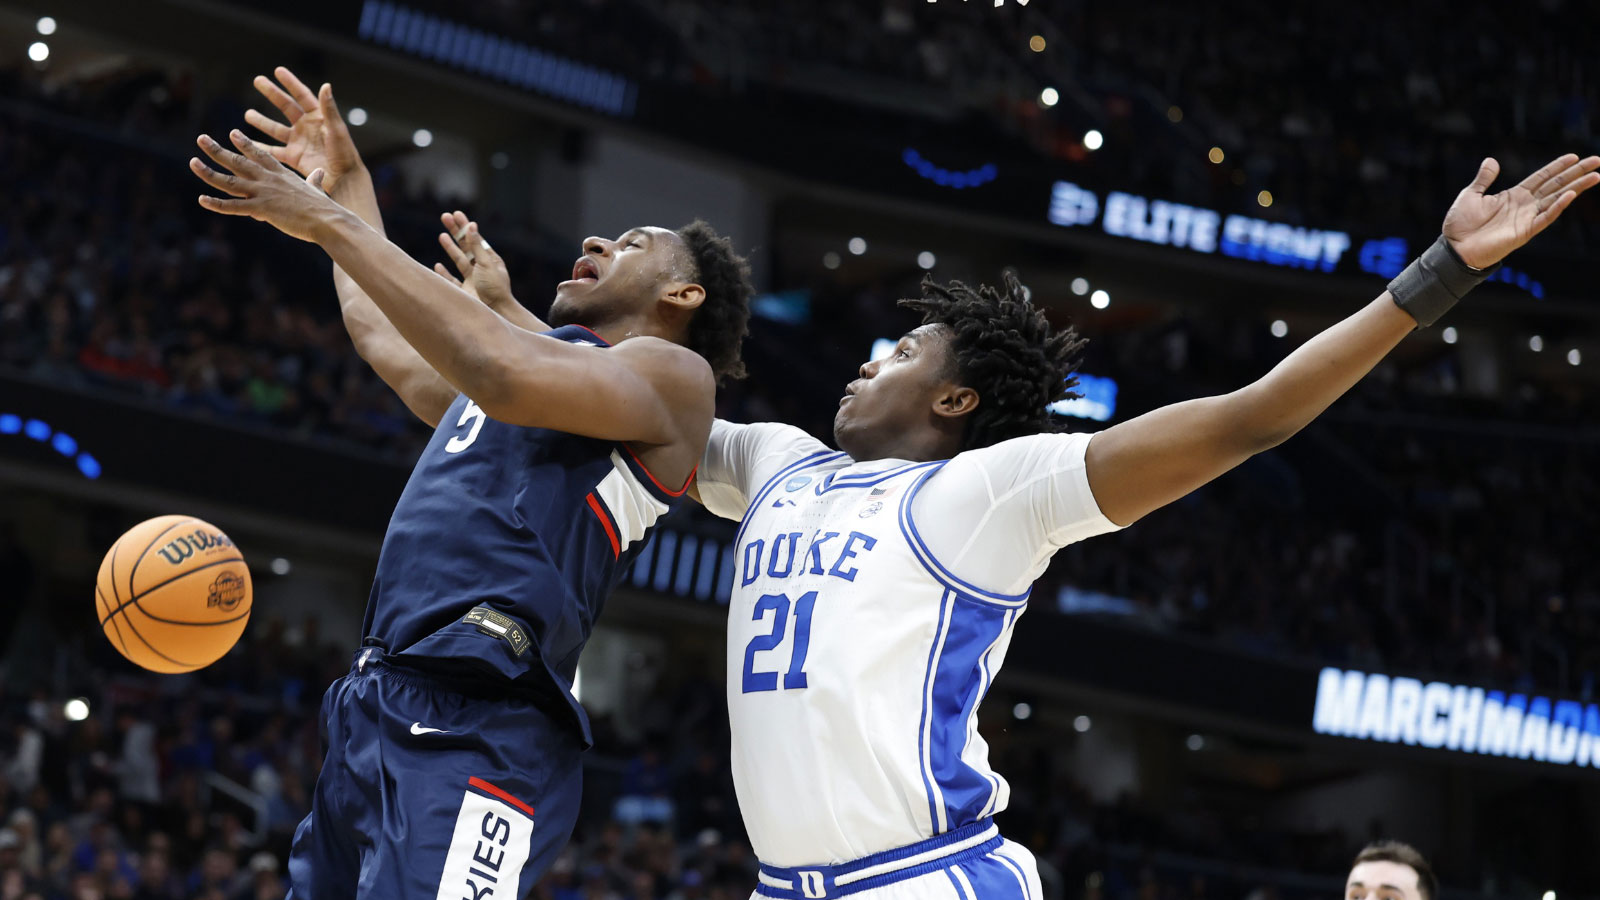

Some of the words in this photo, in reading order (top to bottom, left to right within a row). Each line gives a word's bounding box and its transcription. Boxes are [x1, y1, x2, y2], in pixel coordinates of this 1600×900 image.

[1102, 191, 1220, 253] ELITE
[1221, 214, 1350, 272] EIGHT
[445, 399, 487, 454] 5
[741, 529, 878, 588] DUKE
[742, 591, 818, 694] 21
